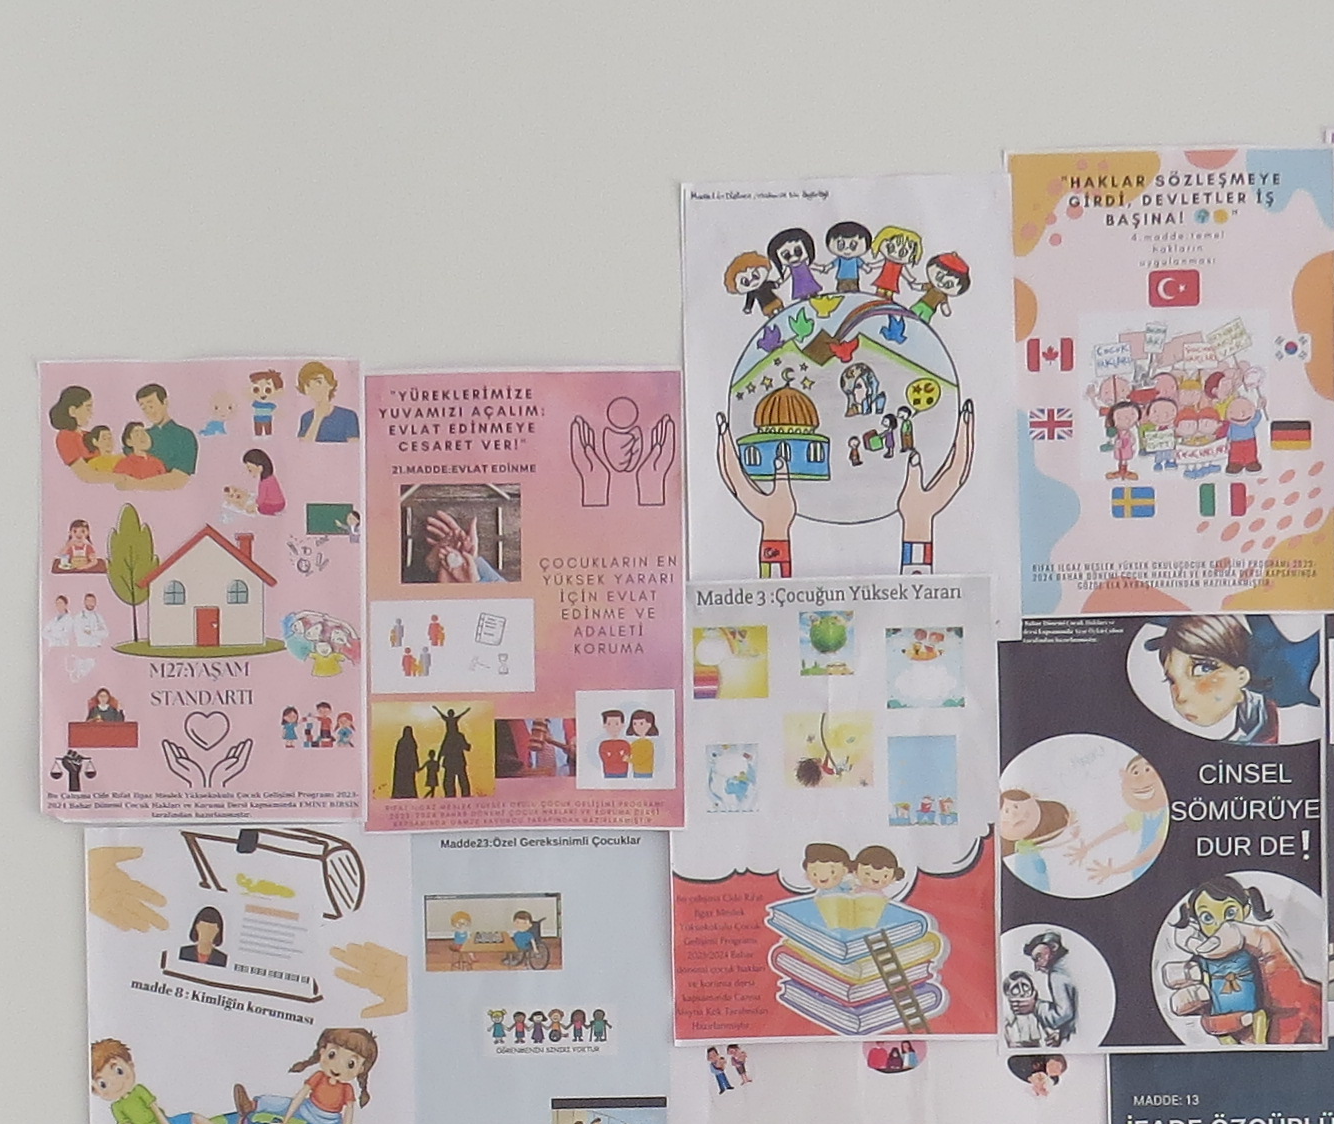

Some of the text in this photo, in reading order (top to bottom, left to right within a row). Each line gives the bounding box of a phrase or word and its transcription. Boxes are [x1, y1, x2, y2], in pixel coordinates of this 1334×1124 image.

[1154, 170, 1280, 188] SÖZLEŞMEYE
[1068, 188, 1274, 209] GİRDİ, DEVLETLER İŞ
[1105, 211, 1184, 229] BAŞINA!
[378, 406, 463, 420] YUVAMIZI
[388, 420, 535, 436] EVLAT EDİNMEYE
[398, 439, 473, 453] CESARET
[490, 462, 536, 474] EDİNME
[538, 555, 677, 573] ÇOCUKLARIN EN
[542, 571, 674, 587] YÜKSEK YARARI
[560, 588, 656, 607] İÇİN EVLAT
[696, 587, 754, 607] Madde
[756, 589, 766, 607] 3
[848, 582, 909, 601] Yüksek
[910, 583, 962, 601] Yararı
[561, 605, 655, 621] EDİNME VE
[573, 622, 643, 638] ADALETİ
[574, 642, 644, 655] KORUMA
[149, 661, 250, 682] M27:YAŞAM
[150, 689, 253, 706] STANDARTI
[1198, 759, 1292, 785] CİNSEL
[1168, 795, 1323, 824] SÖMÜRÜYE
[519, 835, 589, 847] Gereksinimli
[591, 835, 642, 848] Çocuklar
[1196, 836, 1252, 857] DUR
[131, 980, 314, 1025] madde Kimliğin korunması
[1133, 1094, 1200, 1107] MADDE: 13
